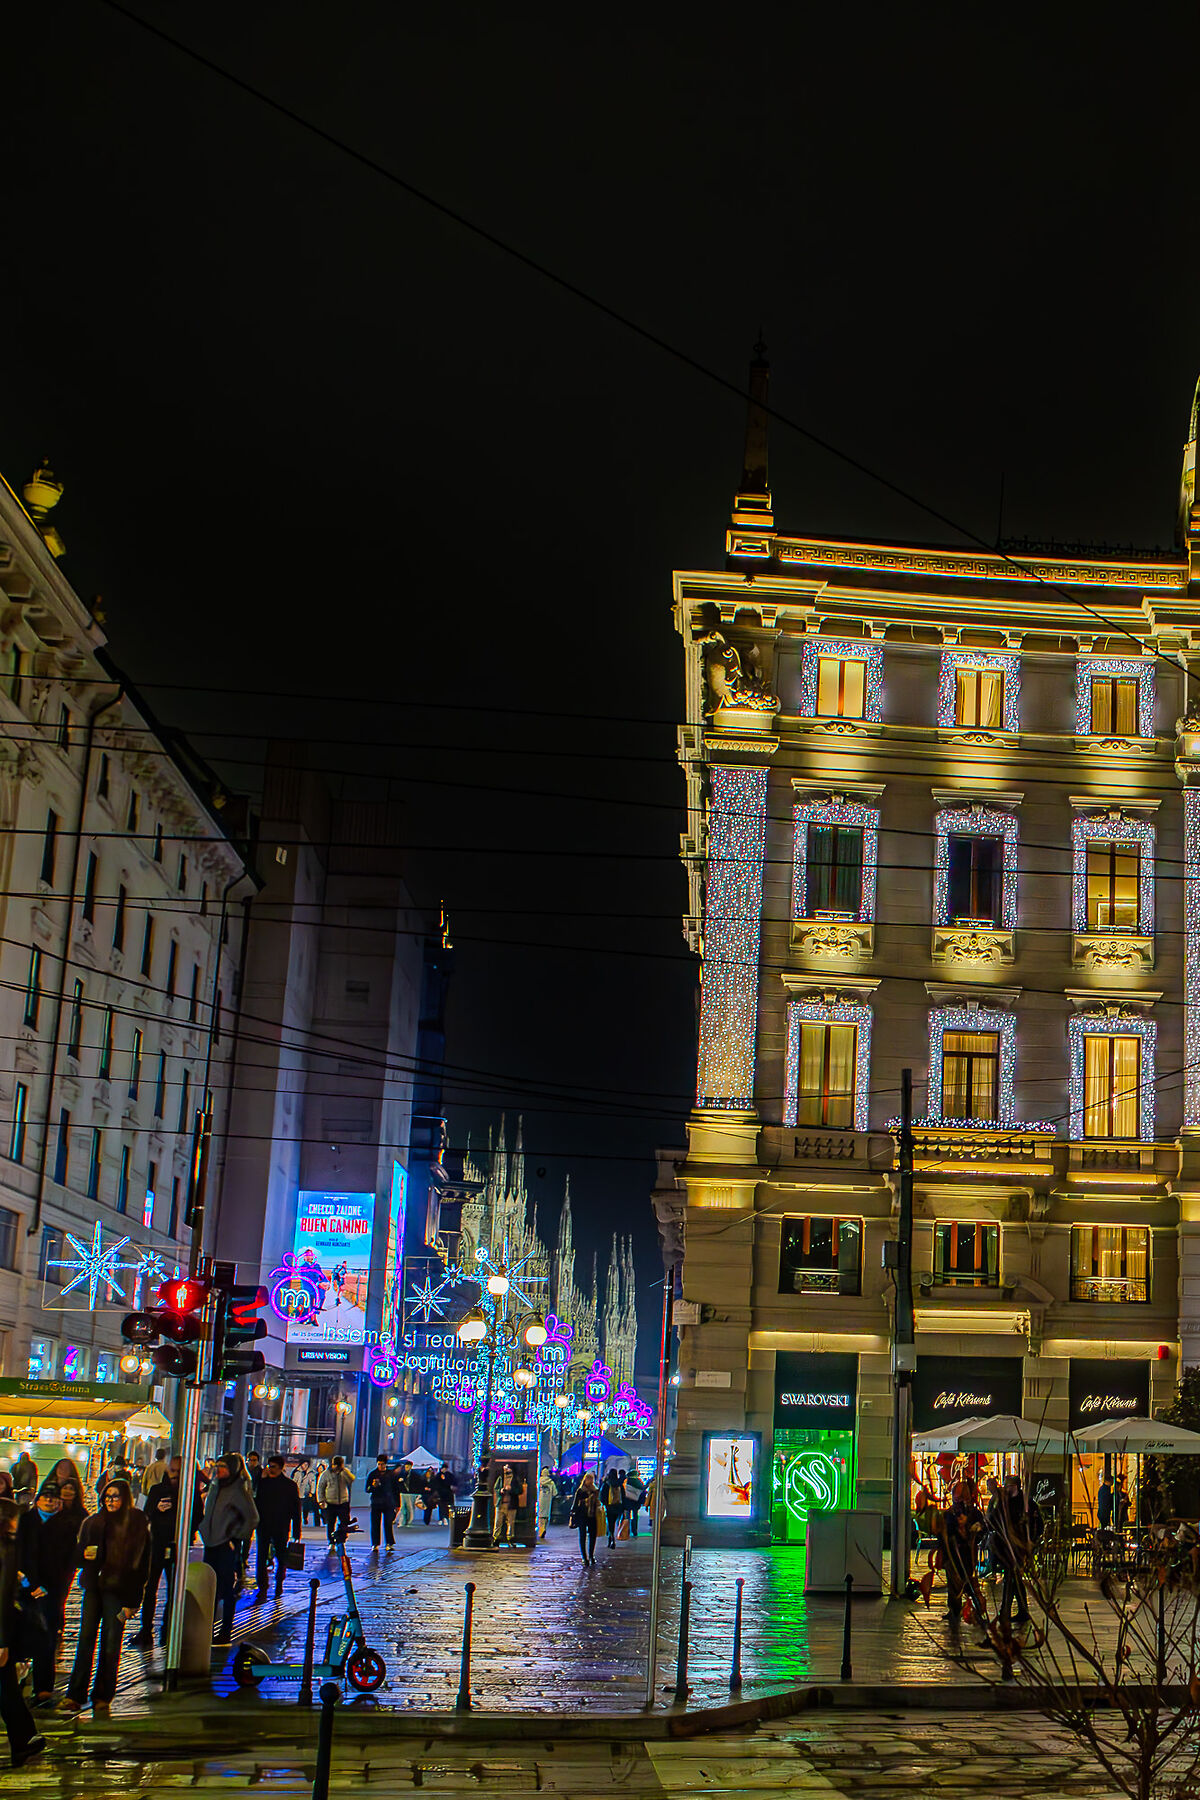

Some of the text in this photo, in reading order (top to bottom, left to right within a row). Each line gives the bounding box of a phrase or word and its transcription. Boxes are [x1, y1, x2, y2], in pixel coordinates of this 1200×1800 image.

[308, 1203, 363, 1217] CHECCO ZALONE
[300, 1217, 368, 1234] BUEN CAMINO
[322, 1322, 393, 1345] Insieme
[301, 1351, 348, 1361] URBAN VISION
[781, 1393, 849, 1407] SWAROVSKI
[496, 1431, 535, 1442] PERCHÉ
